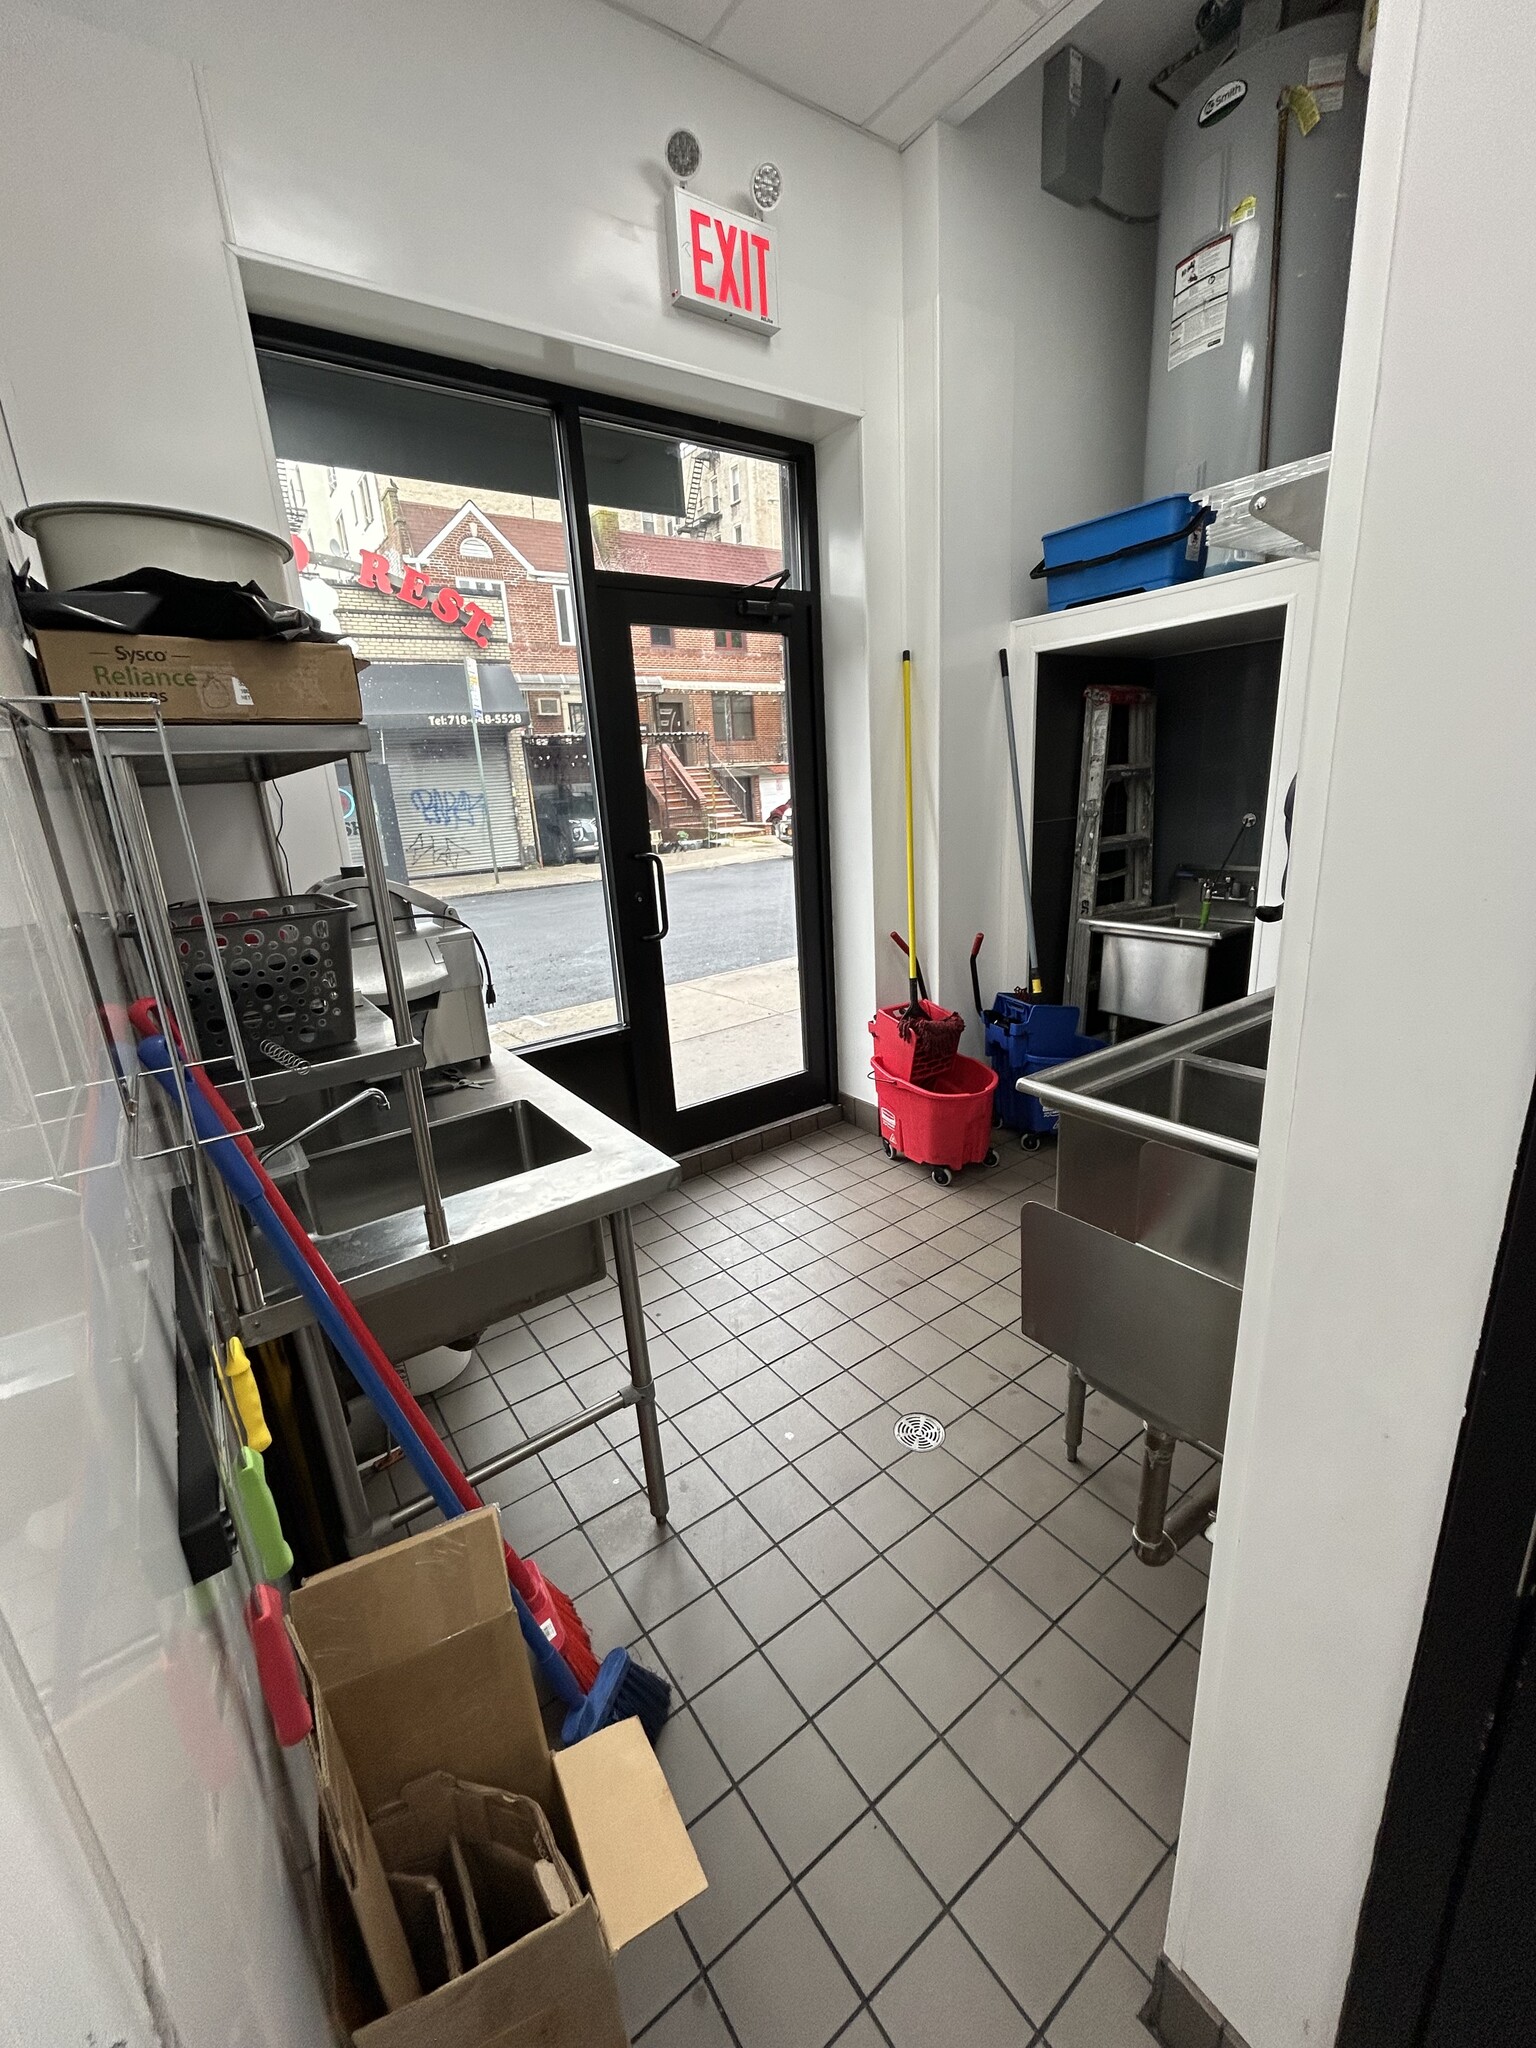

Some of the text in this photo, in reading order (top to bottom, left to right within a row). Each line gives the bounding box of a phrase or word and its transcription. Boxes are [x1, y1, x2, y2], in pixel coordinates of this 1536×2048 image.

[1216, 84, 1241, 107] Smith
[690, 208, 770, 318] EXIT
[358, 549, 494, 649] REST
[114, 645, 168, 665] Sysco
[93, 664, 198, 688] Reliance
